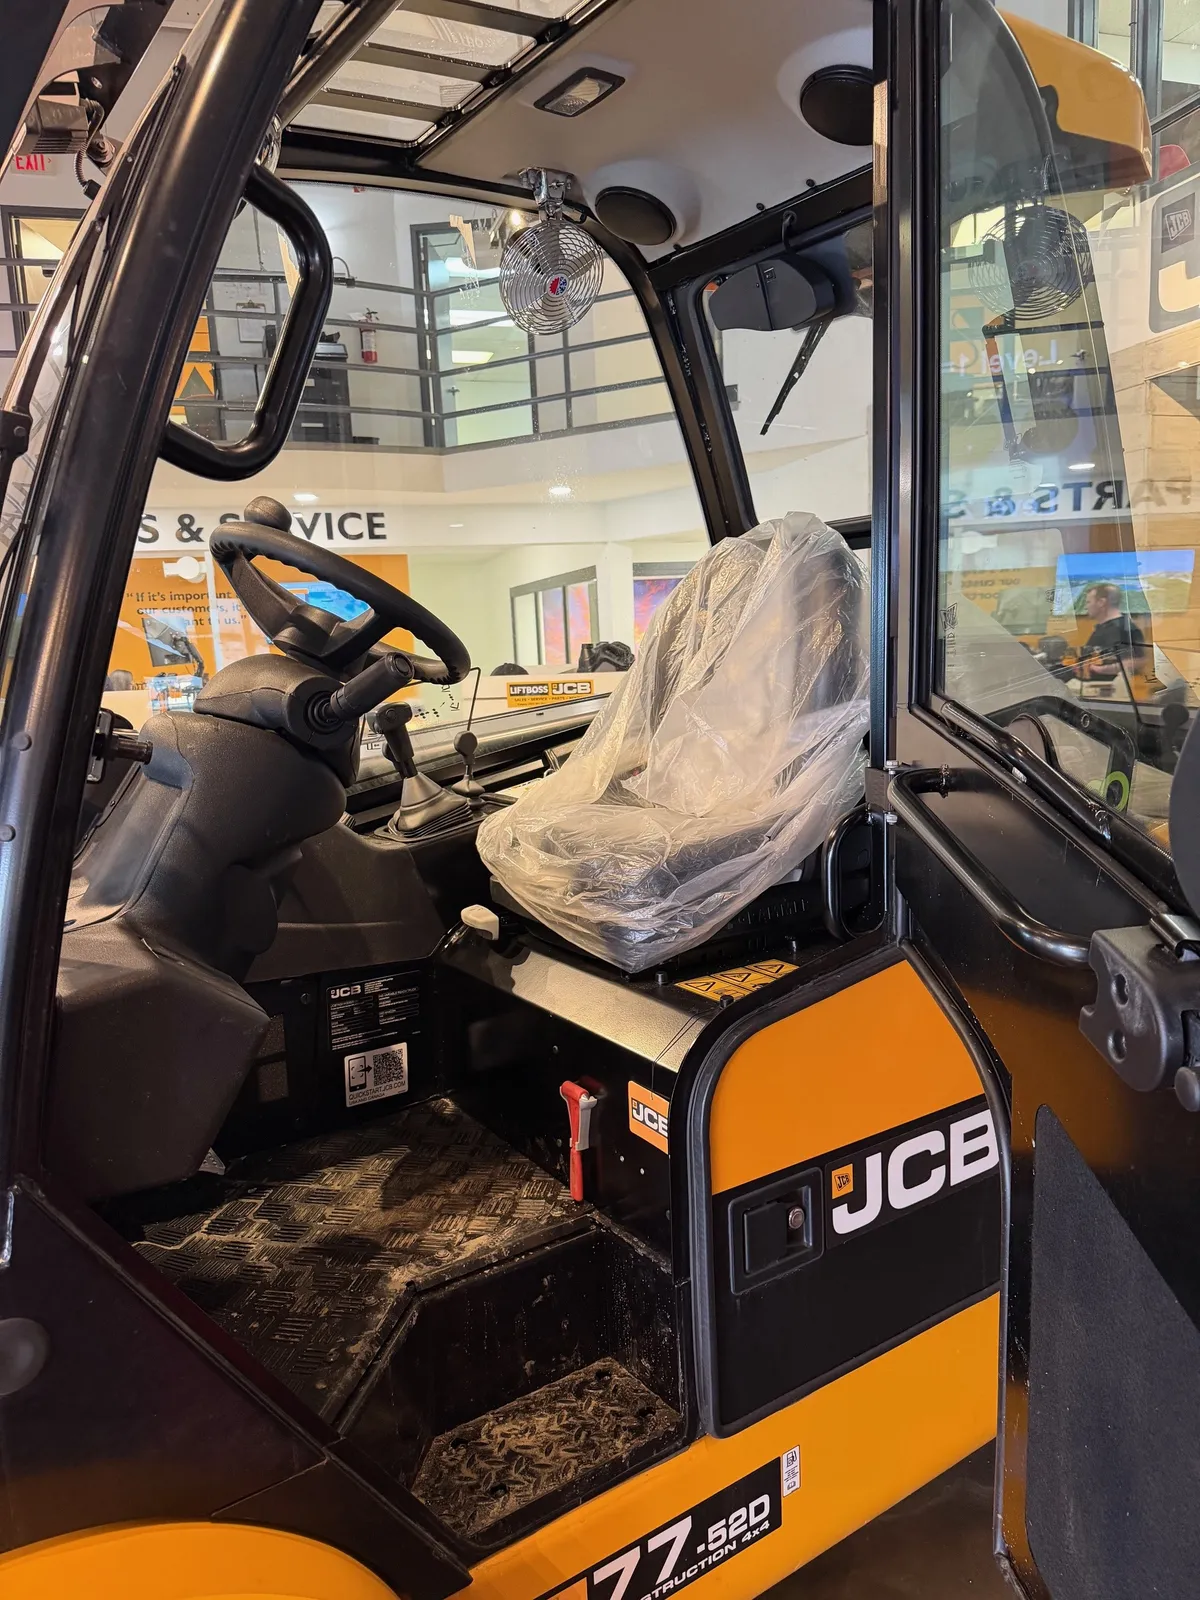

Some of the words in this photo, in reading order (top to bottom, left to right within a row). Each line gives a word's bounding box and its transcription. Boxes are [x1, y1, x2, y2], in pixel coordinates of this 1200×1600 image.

[15, 153, 45, 171] EXIT
[175, 513, 205, 543] &
[219, 512, 387, 541] VICE
[147, 591, 166, 602] it's
[169, 591, 232, 603] impornt
[162, 603, 229, 614] customs,
[510, 685, 548, 694] LIFTBOSS
[552, 681, 591, 695] JCB
[330, 985, 361, 999] JCB
[832, 1109, 1000, 1235] JCB
[741, 1519, 771, 1542] 4x4
